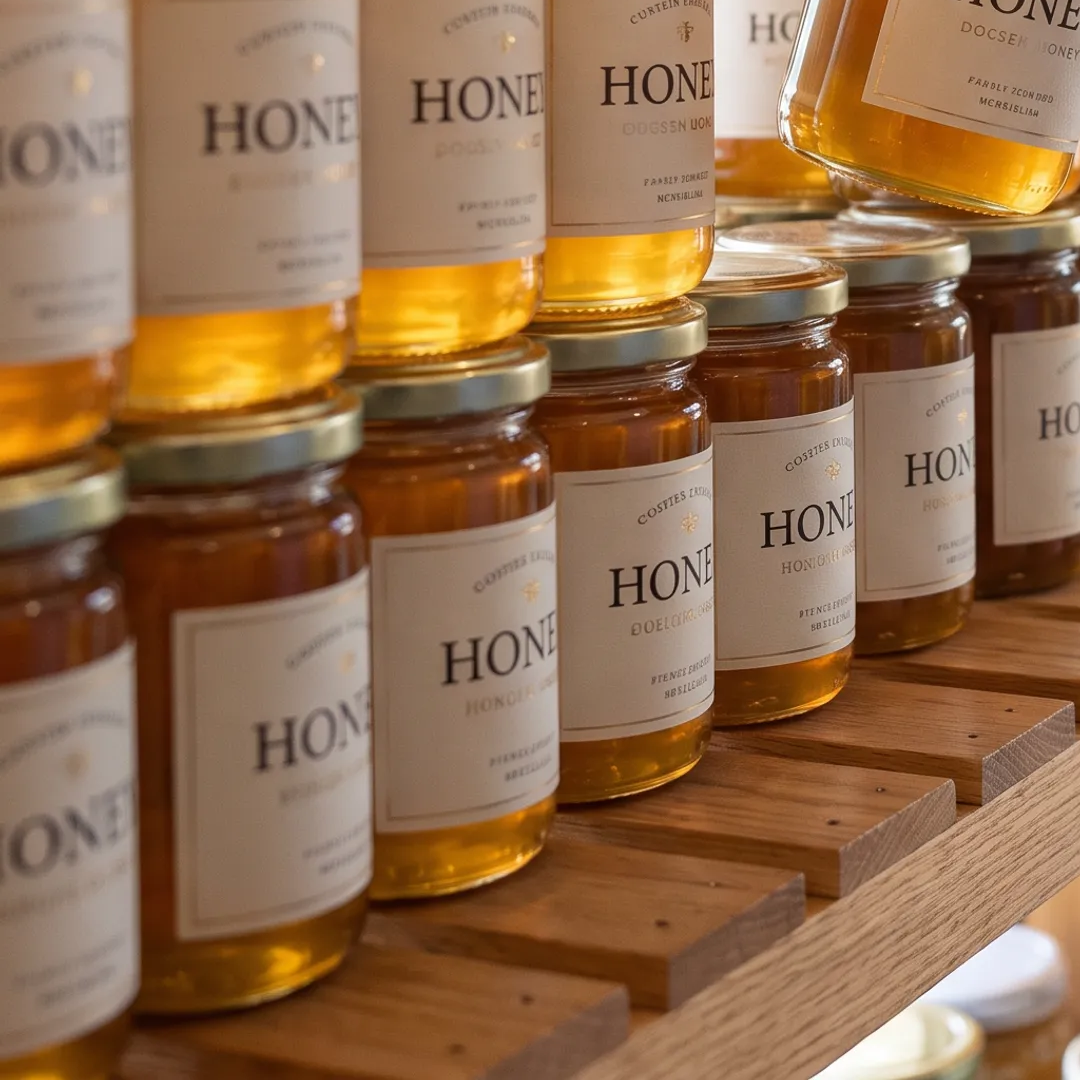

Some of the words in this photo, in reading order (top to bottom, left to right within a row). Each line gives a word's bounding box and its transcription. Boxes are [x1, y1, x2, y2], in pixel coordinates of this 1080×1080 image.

[411, 72, 544, 124] HONE
[600, 59, 714, 106] HONE
[760, 489, 853, 549] HONE
[608, 542, 712, 608] HONE
[440, 609, 556, 686] HONE
